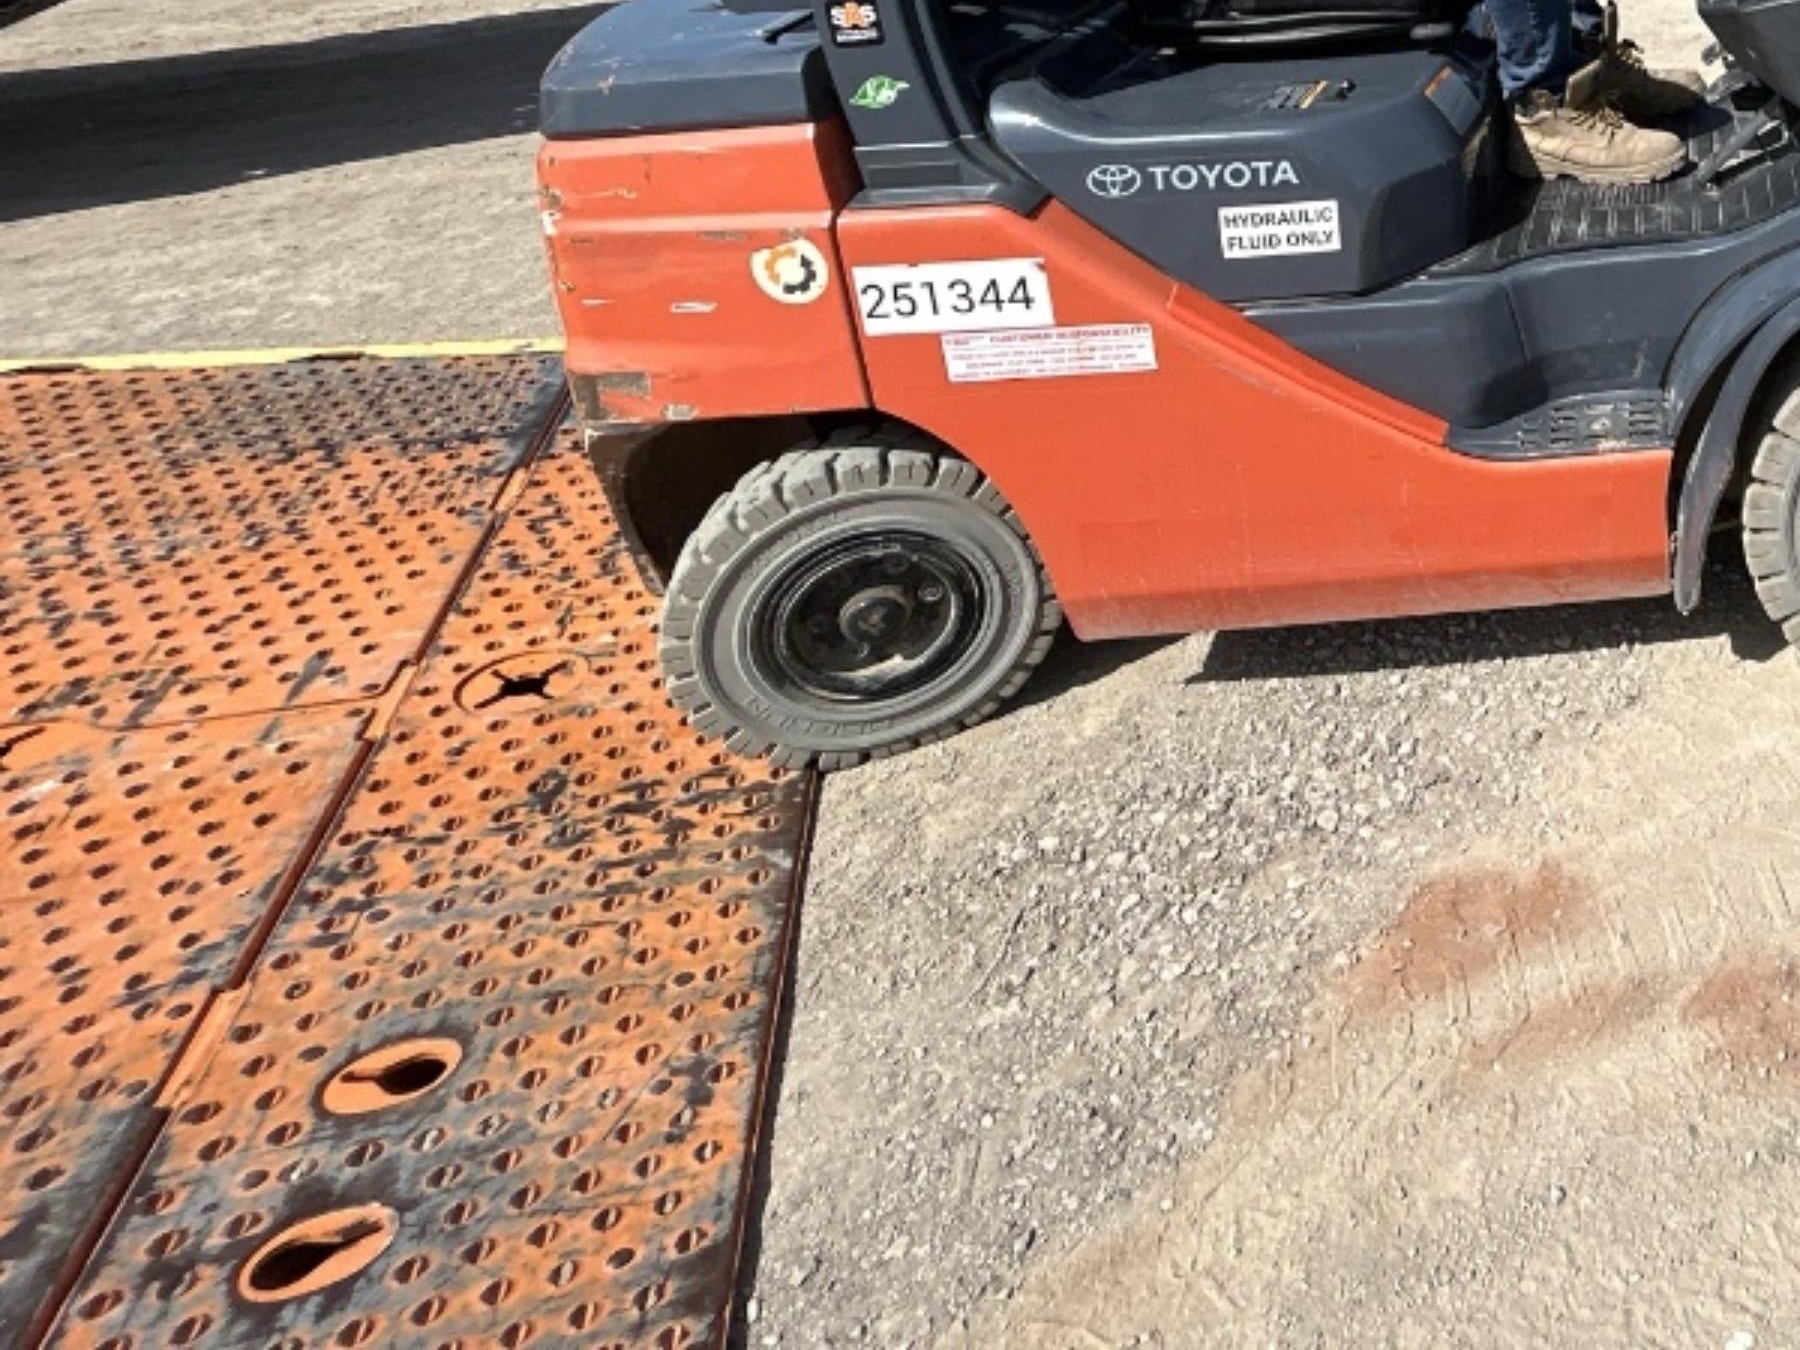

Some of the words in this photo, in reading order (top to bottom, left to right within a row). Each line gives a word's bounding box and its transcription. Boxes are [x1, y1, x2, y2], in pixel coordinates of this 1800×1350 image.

[1147, 159, 1300, 191] TOYOTA
[1222, 206, 1334, 229] HYDRAULIC
[1225, 233, 1282, 252] FLUID
[1285, 229, 1335, 247] ONLY
[860, 275, 1036, 319] 251344
